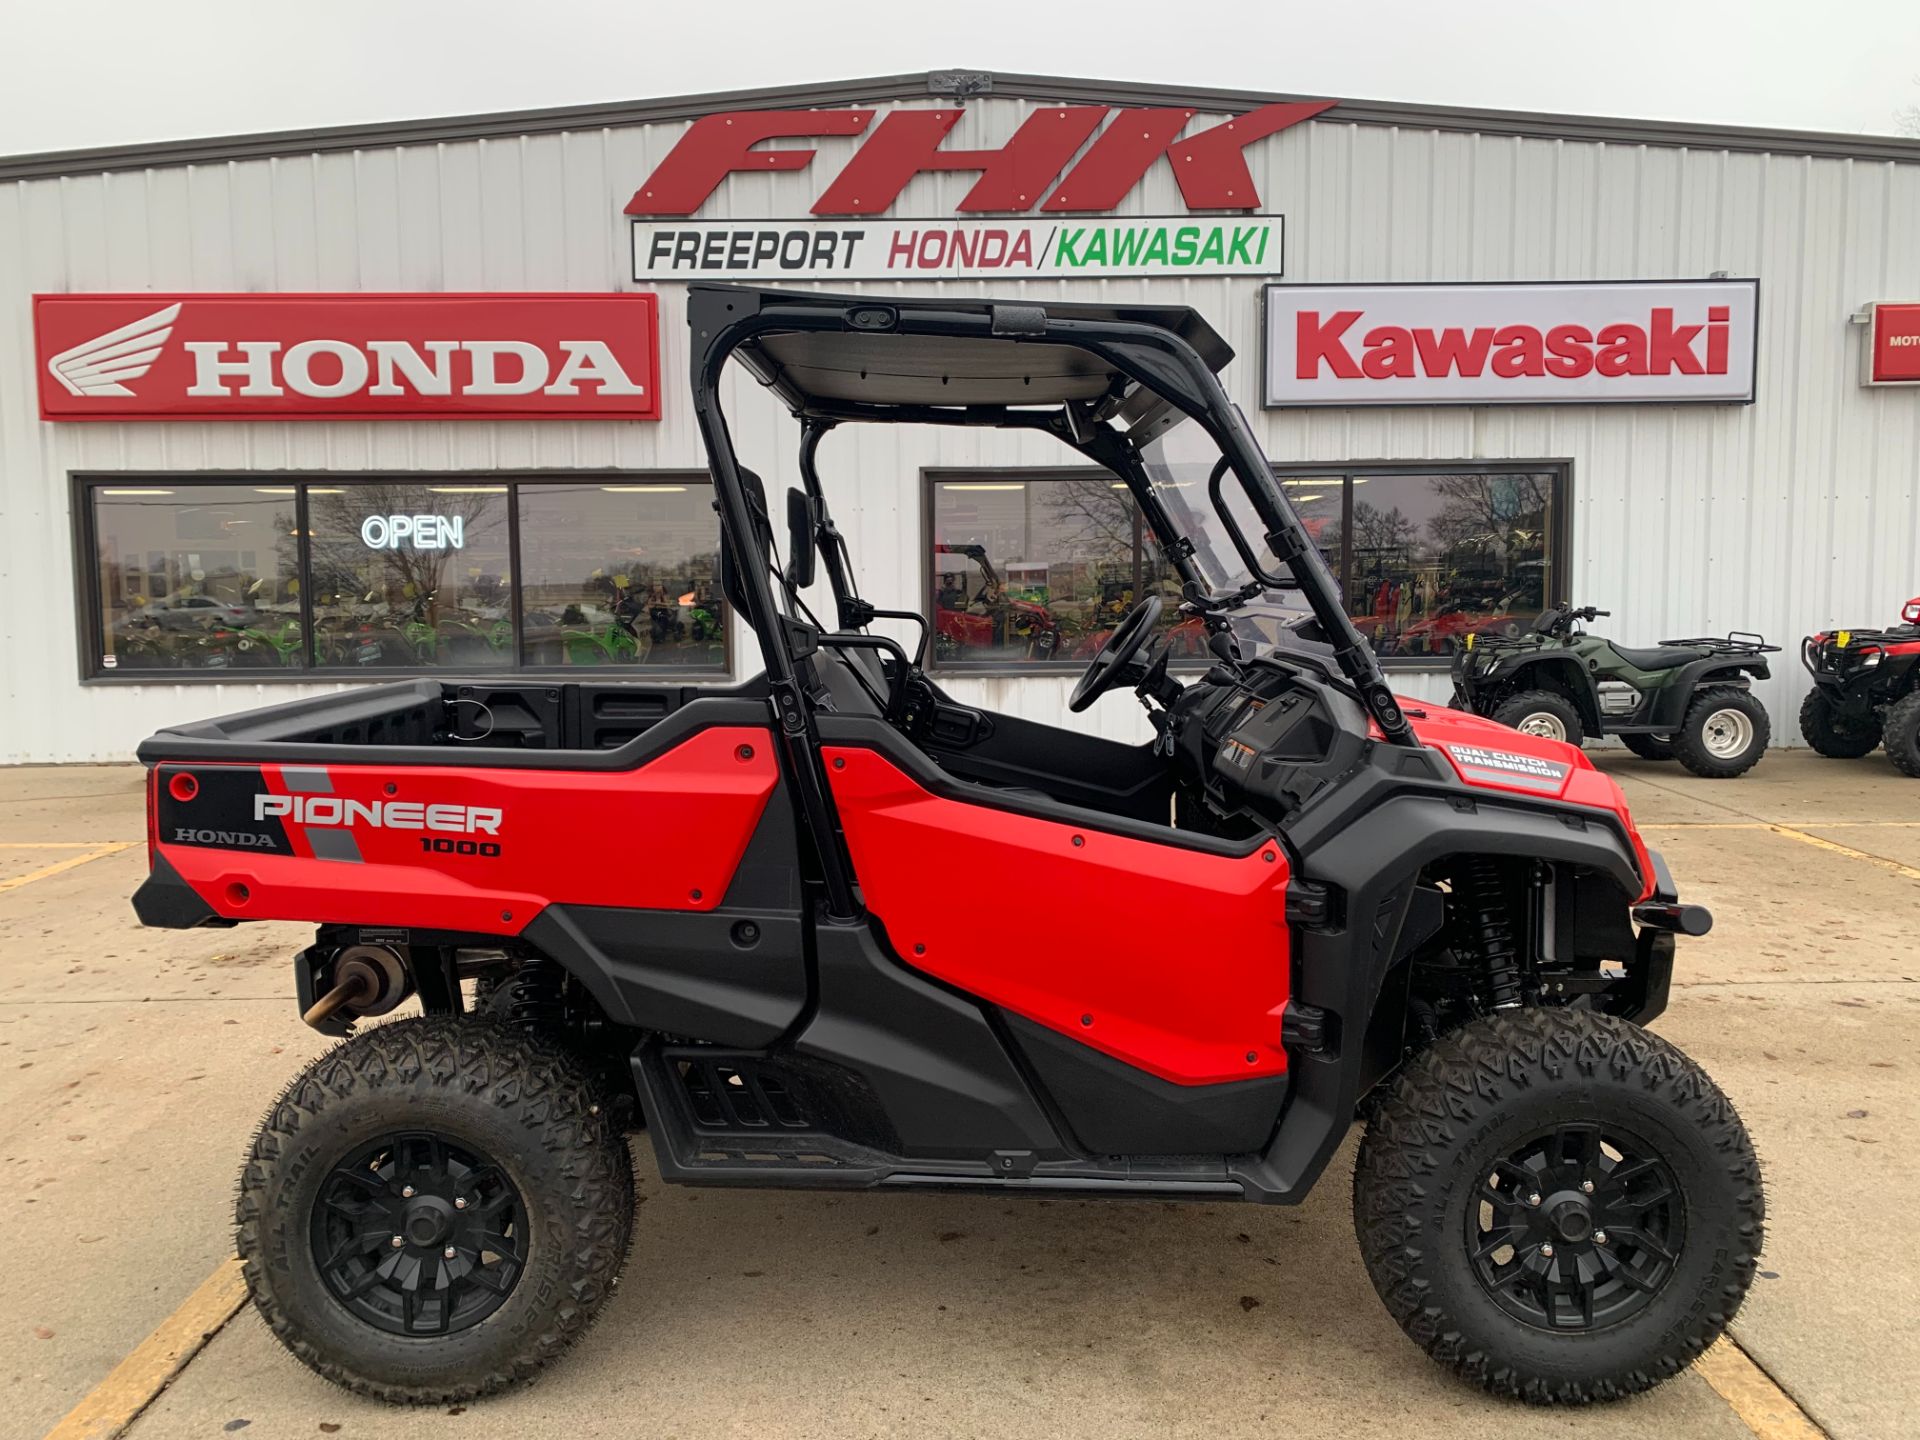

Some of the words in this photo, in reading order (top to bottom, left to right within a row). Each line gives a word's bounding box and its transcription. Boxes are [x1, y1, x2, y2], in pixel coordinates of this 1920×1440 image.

[624, 100, 1341, 215] FHK
[647, 230, 865, 270] FREEPORT
[1296, 305, 1729, 379] Kawasaki
[184, 339, 645, 398] HONDA
[361, 514, 463, 550] OPEN
[1449, 745, 1489, 758] DUAL
[1492, 751, 1548, 768] CLUTCH
[1455, 754, 1562, 778] TRANSMISSION
[254, 793, 503, 836] PIONEER
[174, 828, 277, 848] HONDA
[420, 837, 502, 857] 1000
